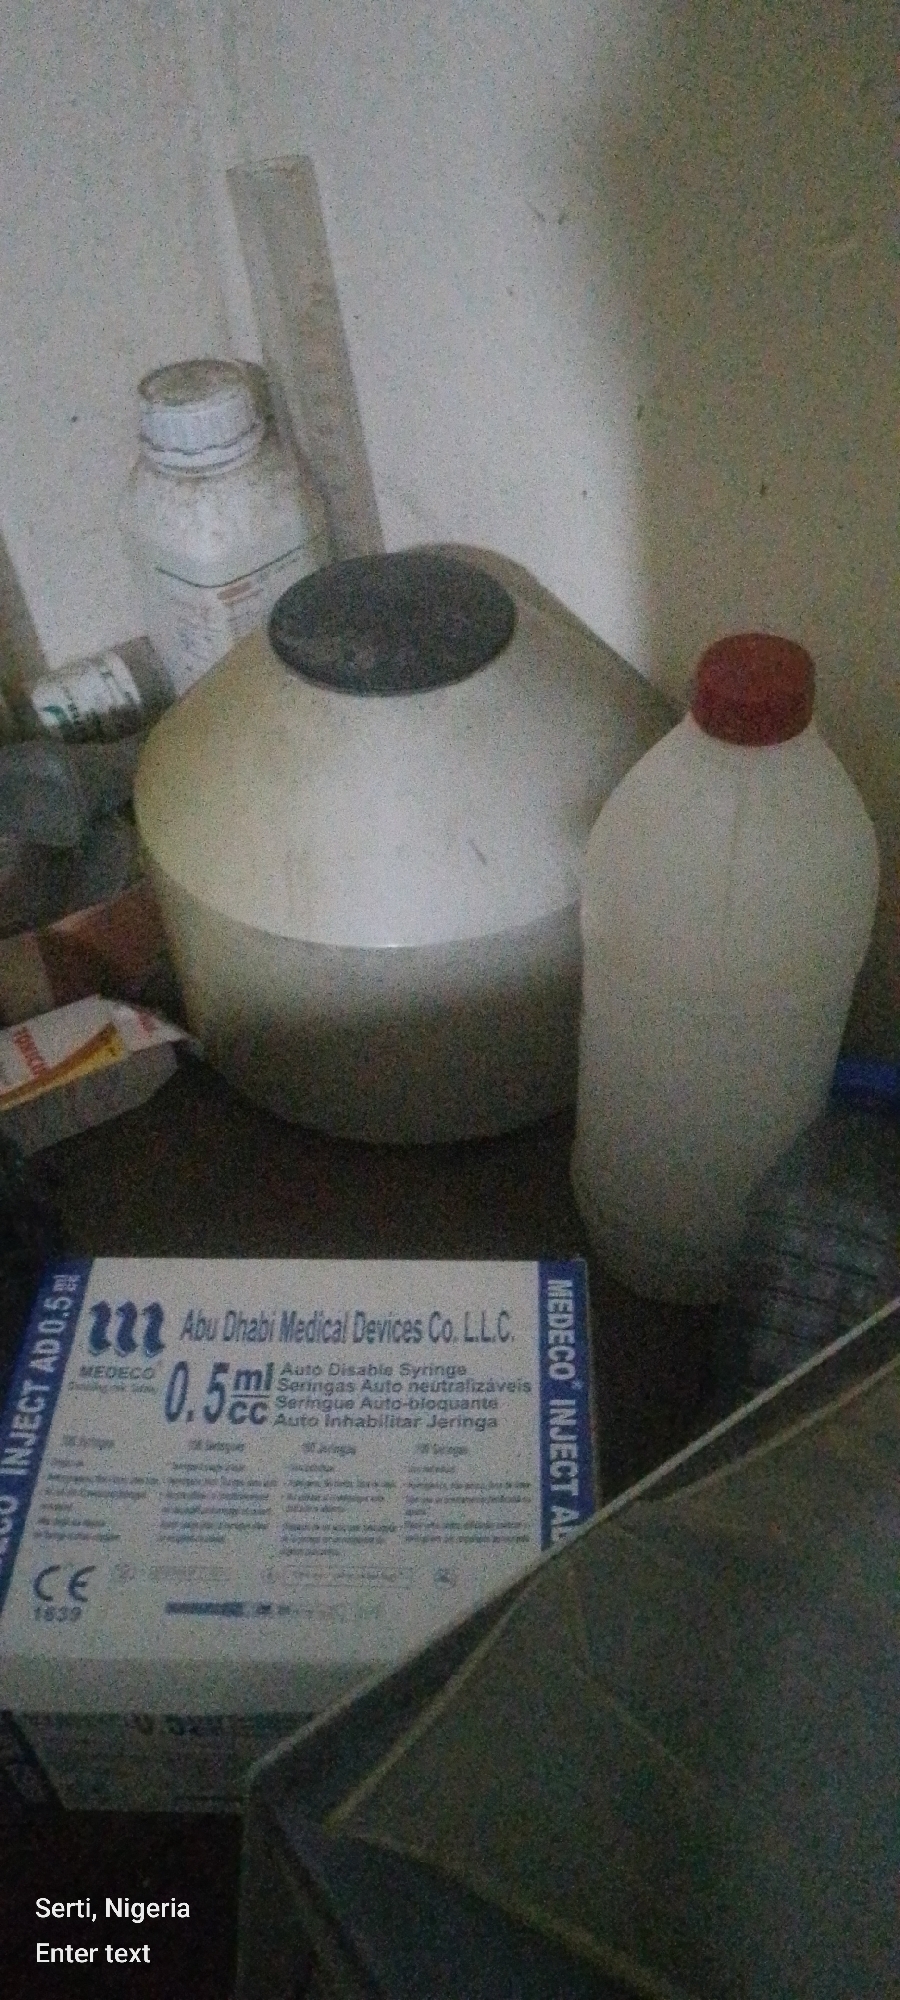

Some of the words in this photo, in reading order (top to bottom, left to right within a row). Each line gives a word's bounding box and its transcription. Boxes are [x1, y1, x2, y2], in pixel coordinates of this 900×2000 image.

[180, 1308, 219, 1342] Abu
[222, 1309, 276, 1342] Dhabi
[279, 1309, 349, 1344] Medical
[353, 1310, 423, 1344] Devices
[429, 1310, 459, 1344] Co.
[464, 1310, 515, 1344] L.L.C.
[233, 1362, 275, 1391] ml
[279, 1362, 323, 1376] Auto
[328, 1362, 394, 1377] Disable
[400, 1363, 468, 1380] Syringe
[277, 1378, 356, 1396] Seringas
[362, 1379, 402, 1393] Auto
[408, 1377, 533, 1394] neutralizáveis
[228, 1400, 268, 1425] cc
[275, 1395, 355, 1412] Seringue
[360, 1397, 499, 1413] Auto-bloquante
[0, 1379, 50, 1476] INJECT
[274, 1413, 319, 1427] Auto
[324, 1414, 422, 1429] Inhabilitar
[427, 1415, 498, 1432] Jeringa
[549, 1399, 580, 1497] INJECT
